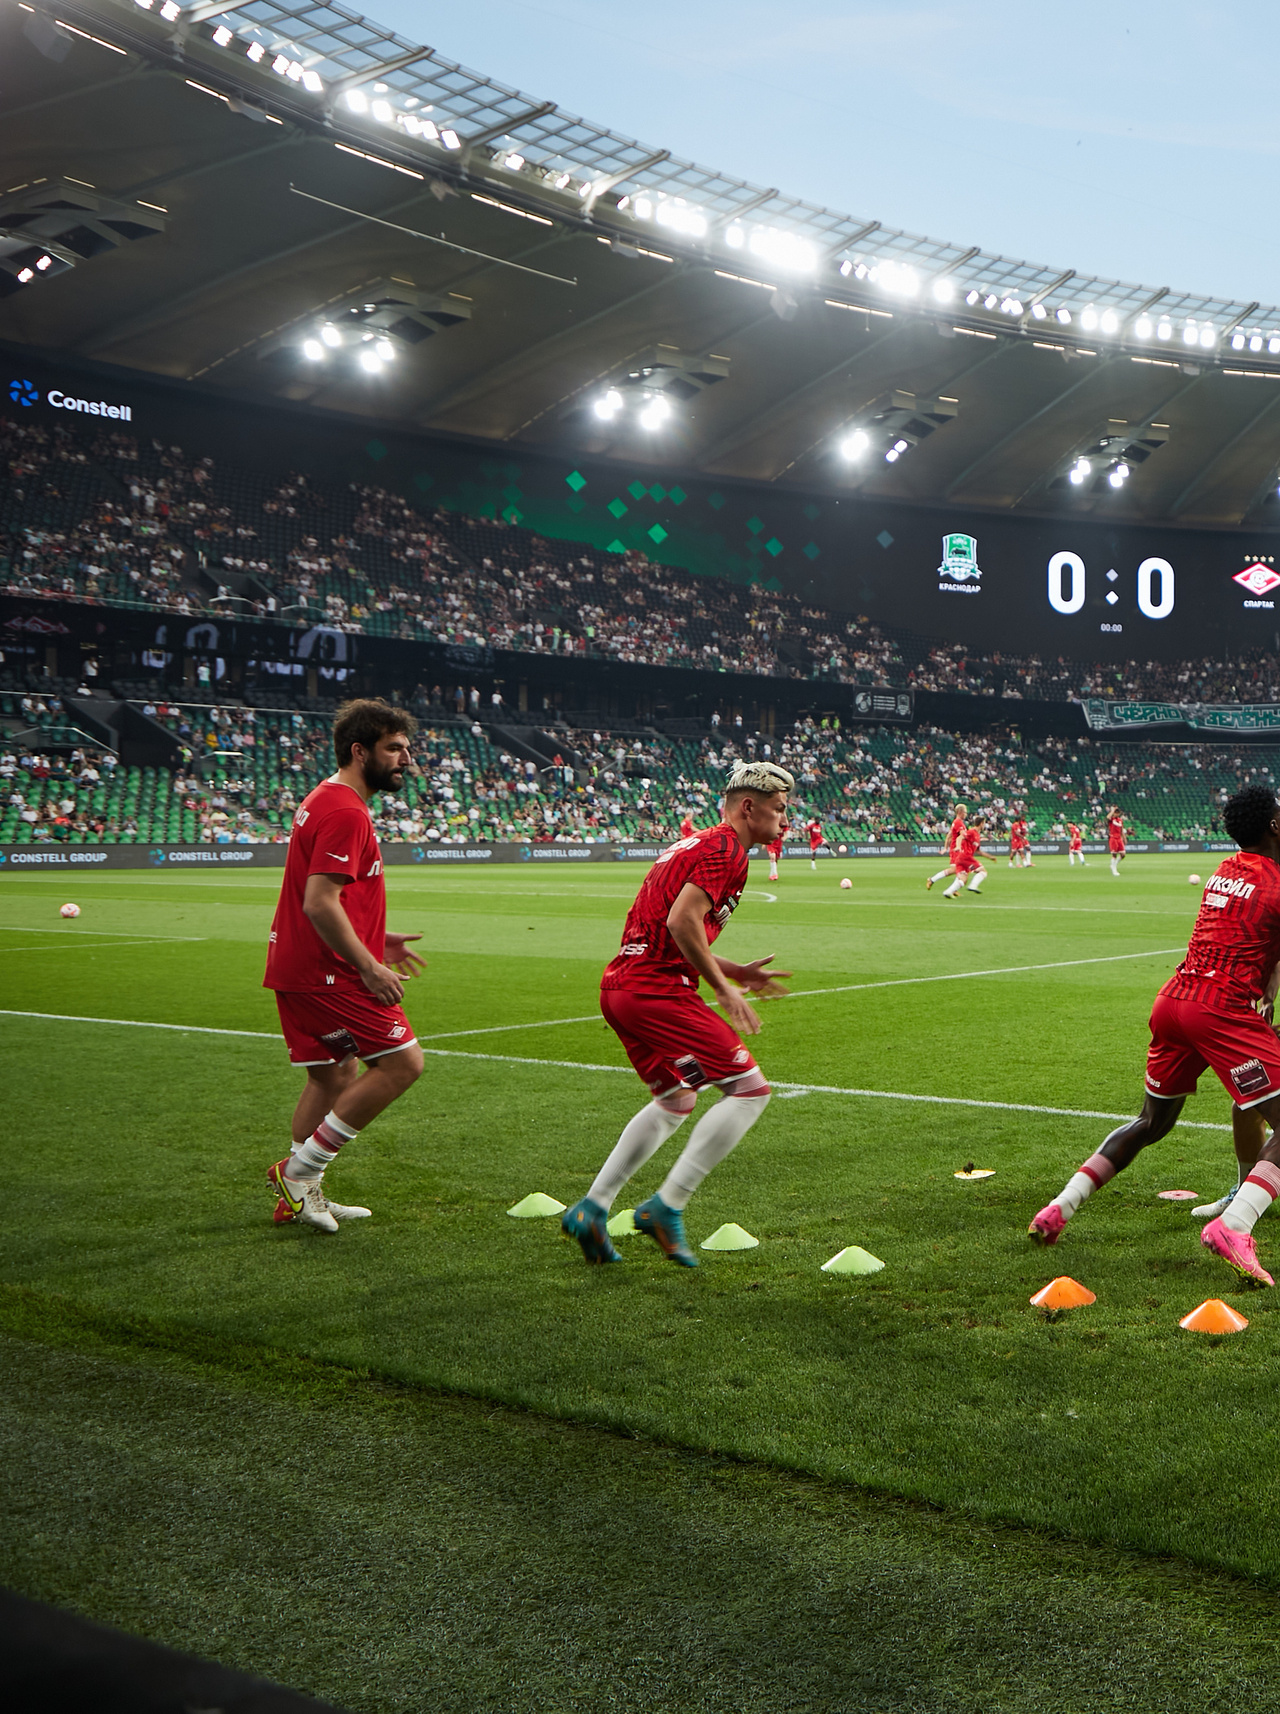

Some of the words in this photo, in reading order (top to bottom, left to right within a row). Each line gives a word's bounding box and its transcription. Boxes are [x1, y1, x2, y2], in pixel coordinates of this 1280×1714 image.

[47, 389, 132, 421] Constell
[939, 582, 982, 593] КРАСНОДАР
[1048, 551, 1086, 614] 0
[1137, 557, 1175, 619] 0
[1243, 600, 1275, 609] СПАРТАК
[1100, 623, 1123, 633] 00:00
[10, 853, 69, 863] CONSTELL
[69, 852, 108, 862] GROUP
[168, 851, 220, 861] CONSTELL
[220, 851, 254, 860] GROUP
[426, 849, 466, 859] CONSTELL
[466, 849, 493, 858] GROUP
[533, 849, 568, 858] CONSTELL
[568, 848, 592, 857] GROUP
[627, 848, 659, 857] CONSTELL
[1230, 1058, 1260, 1075] ЛУКОЙЛ
